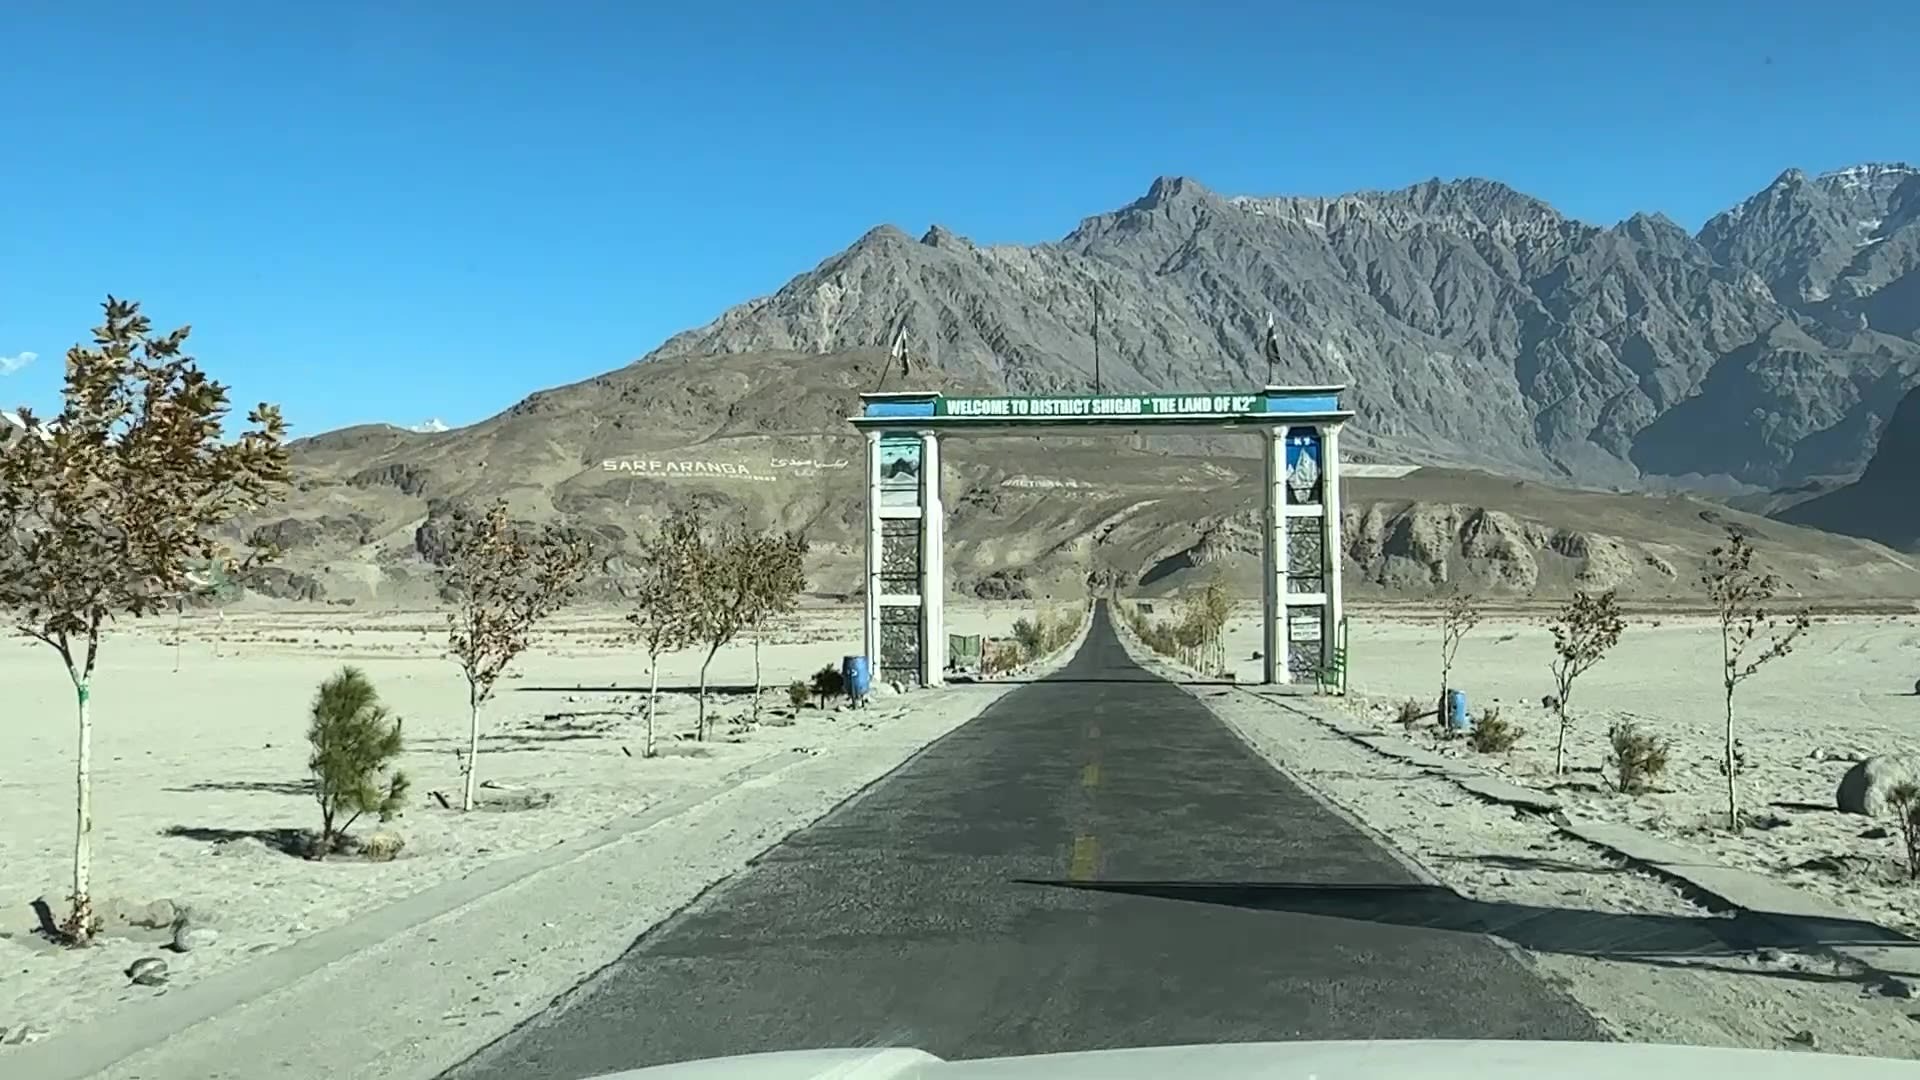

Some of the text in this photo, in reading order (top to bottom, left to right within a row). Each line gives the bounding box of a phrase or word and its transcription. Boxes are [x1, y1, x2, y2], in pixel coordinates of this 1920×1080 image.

[947, 400, 1010, 415] WELCOME
[1012, 400, 1029, 415] TO
[1030, 399, 1091, 414] DISTRICT
[1092, 399, 1141, 413] SHIGAR
[1178, 398, 1211, 412] LAND
[1214, 397, 1231, 412] OF
[602, 460, 750, 475] SARFARANGA
